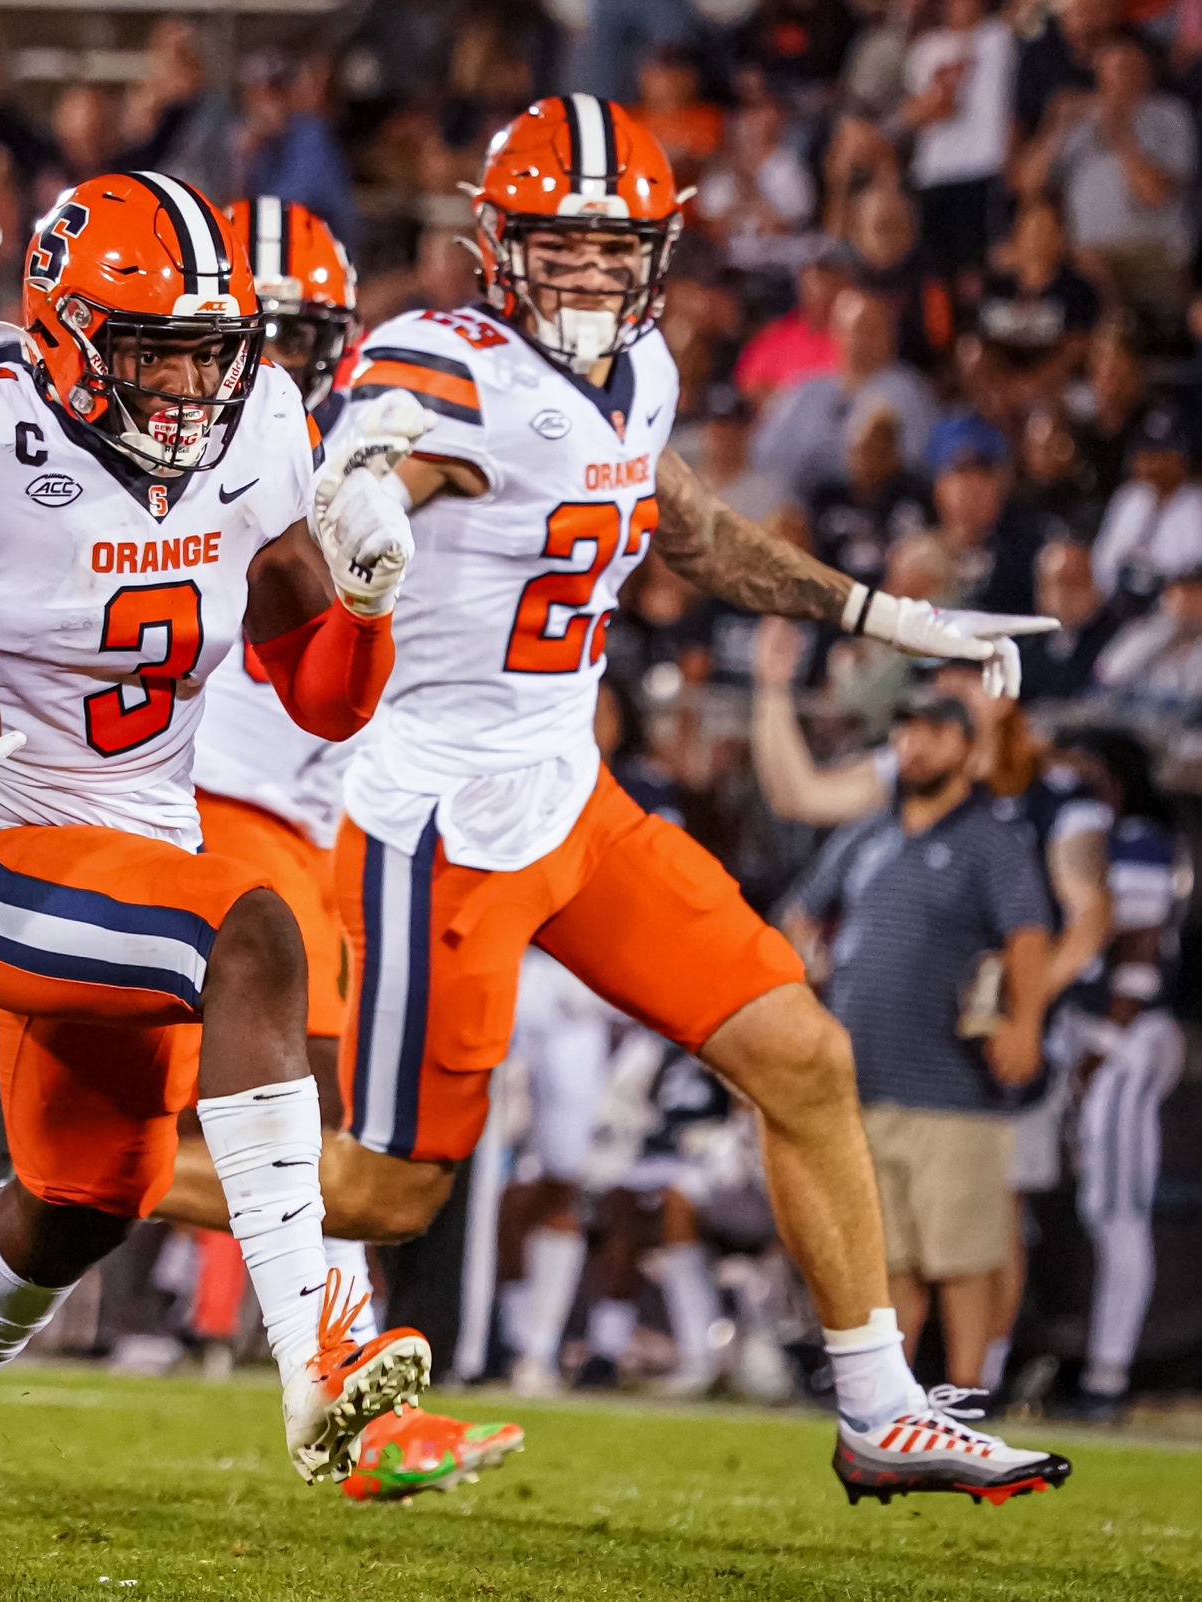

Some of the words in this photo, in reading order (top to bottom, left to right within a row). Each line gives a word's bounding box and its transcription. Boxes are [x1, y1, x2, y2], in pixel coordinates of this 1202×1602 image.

[15, 420, 48, 467] C
[34, 481, 75, 493] ACC
[585, 453, 651, 491] ORANGE
[149, 485, 169, 517] S
[91, 531, 222, 574] ORANGE
[83, 579, 204, 759] 3
